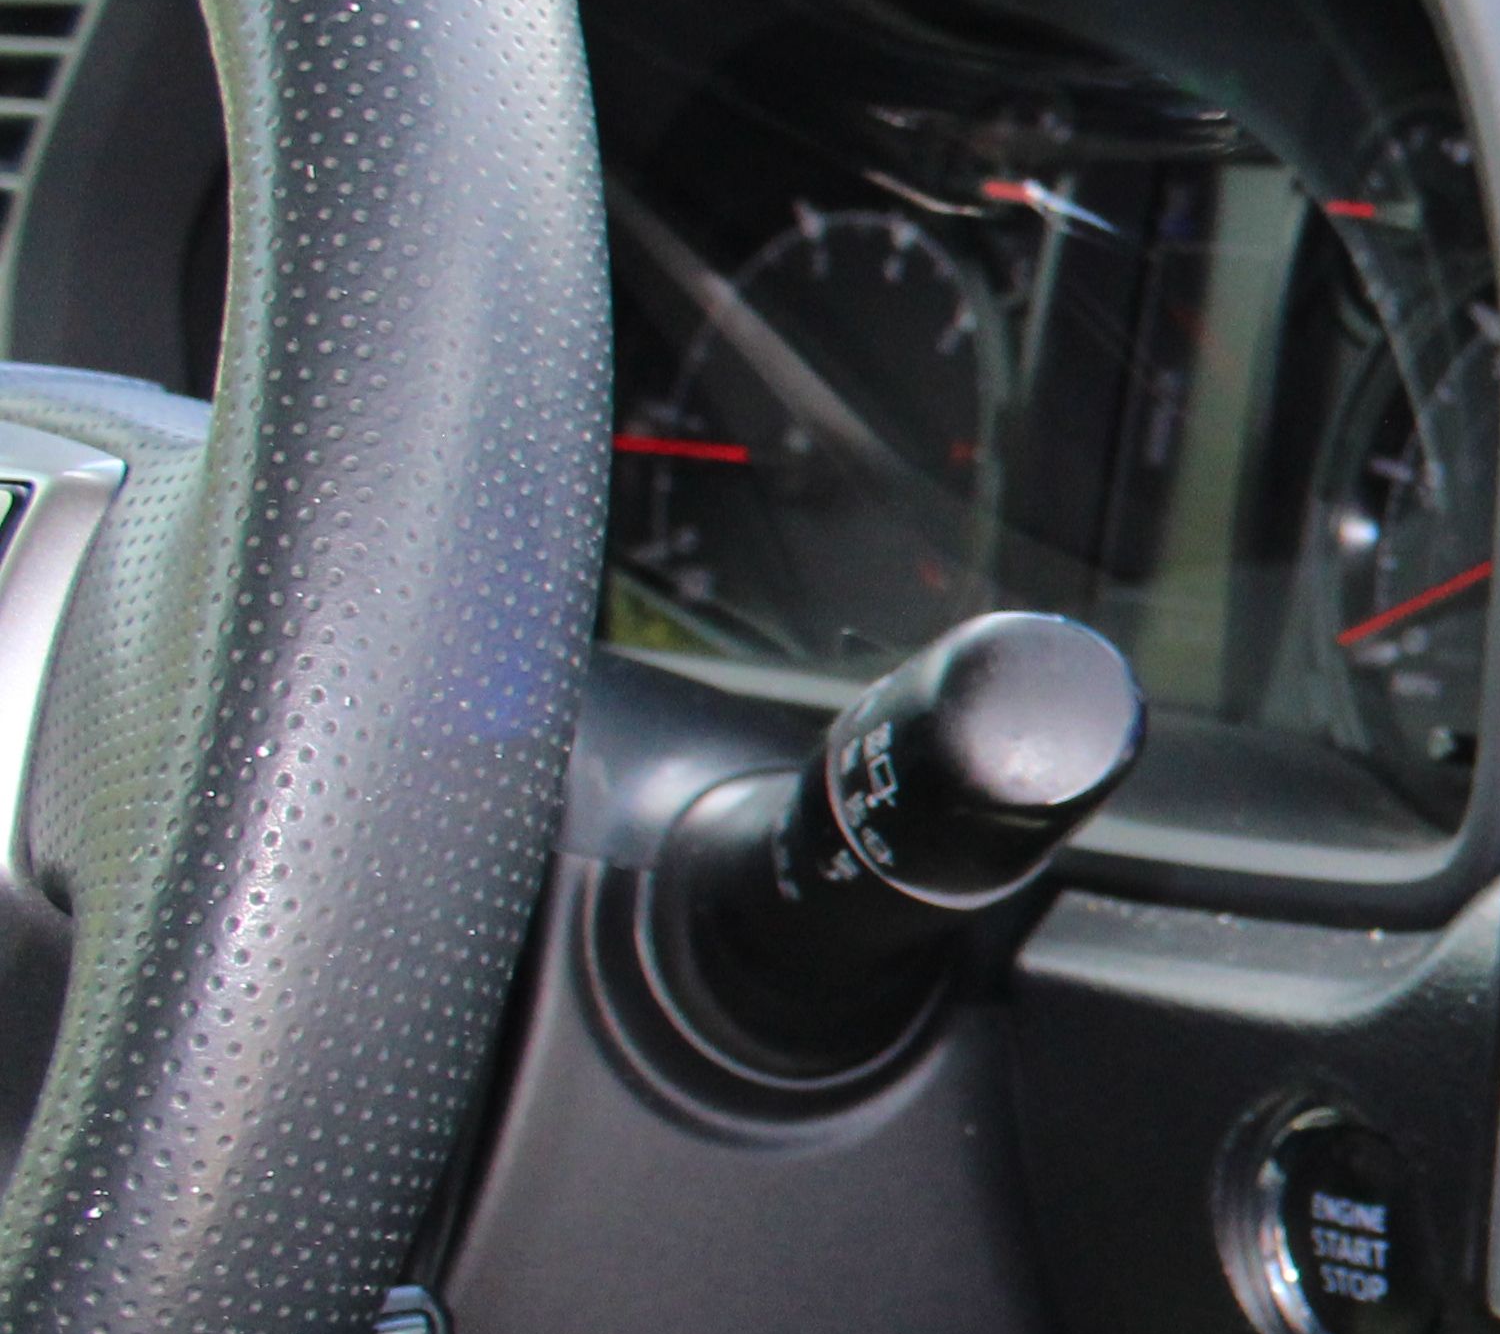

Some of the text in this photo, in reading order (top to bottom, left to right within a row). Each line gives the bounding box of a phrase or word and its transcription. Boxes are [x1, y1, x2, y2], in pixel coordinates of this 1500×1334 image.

[1310, 1191, 1388, 1234] ENGINE
[1310, 1224, 1390, 1270] START
[1318, 1264, 1389, 1303] STOP
